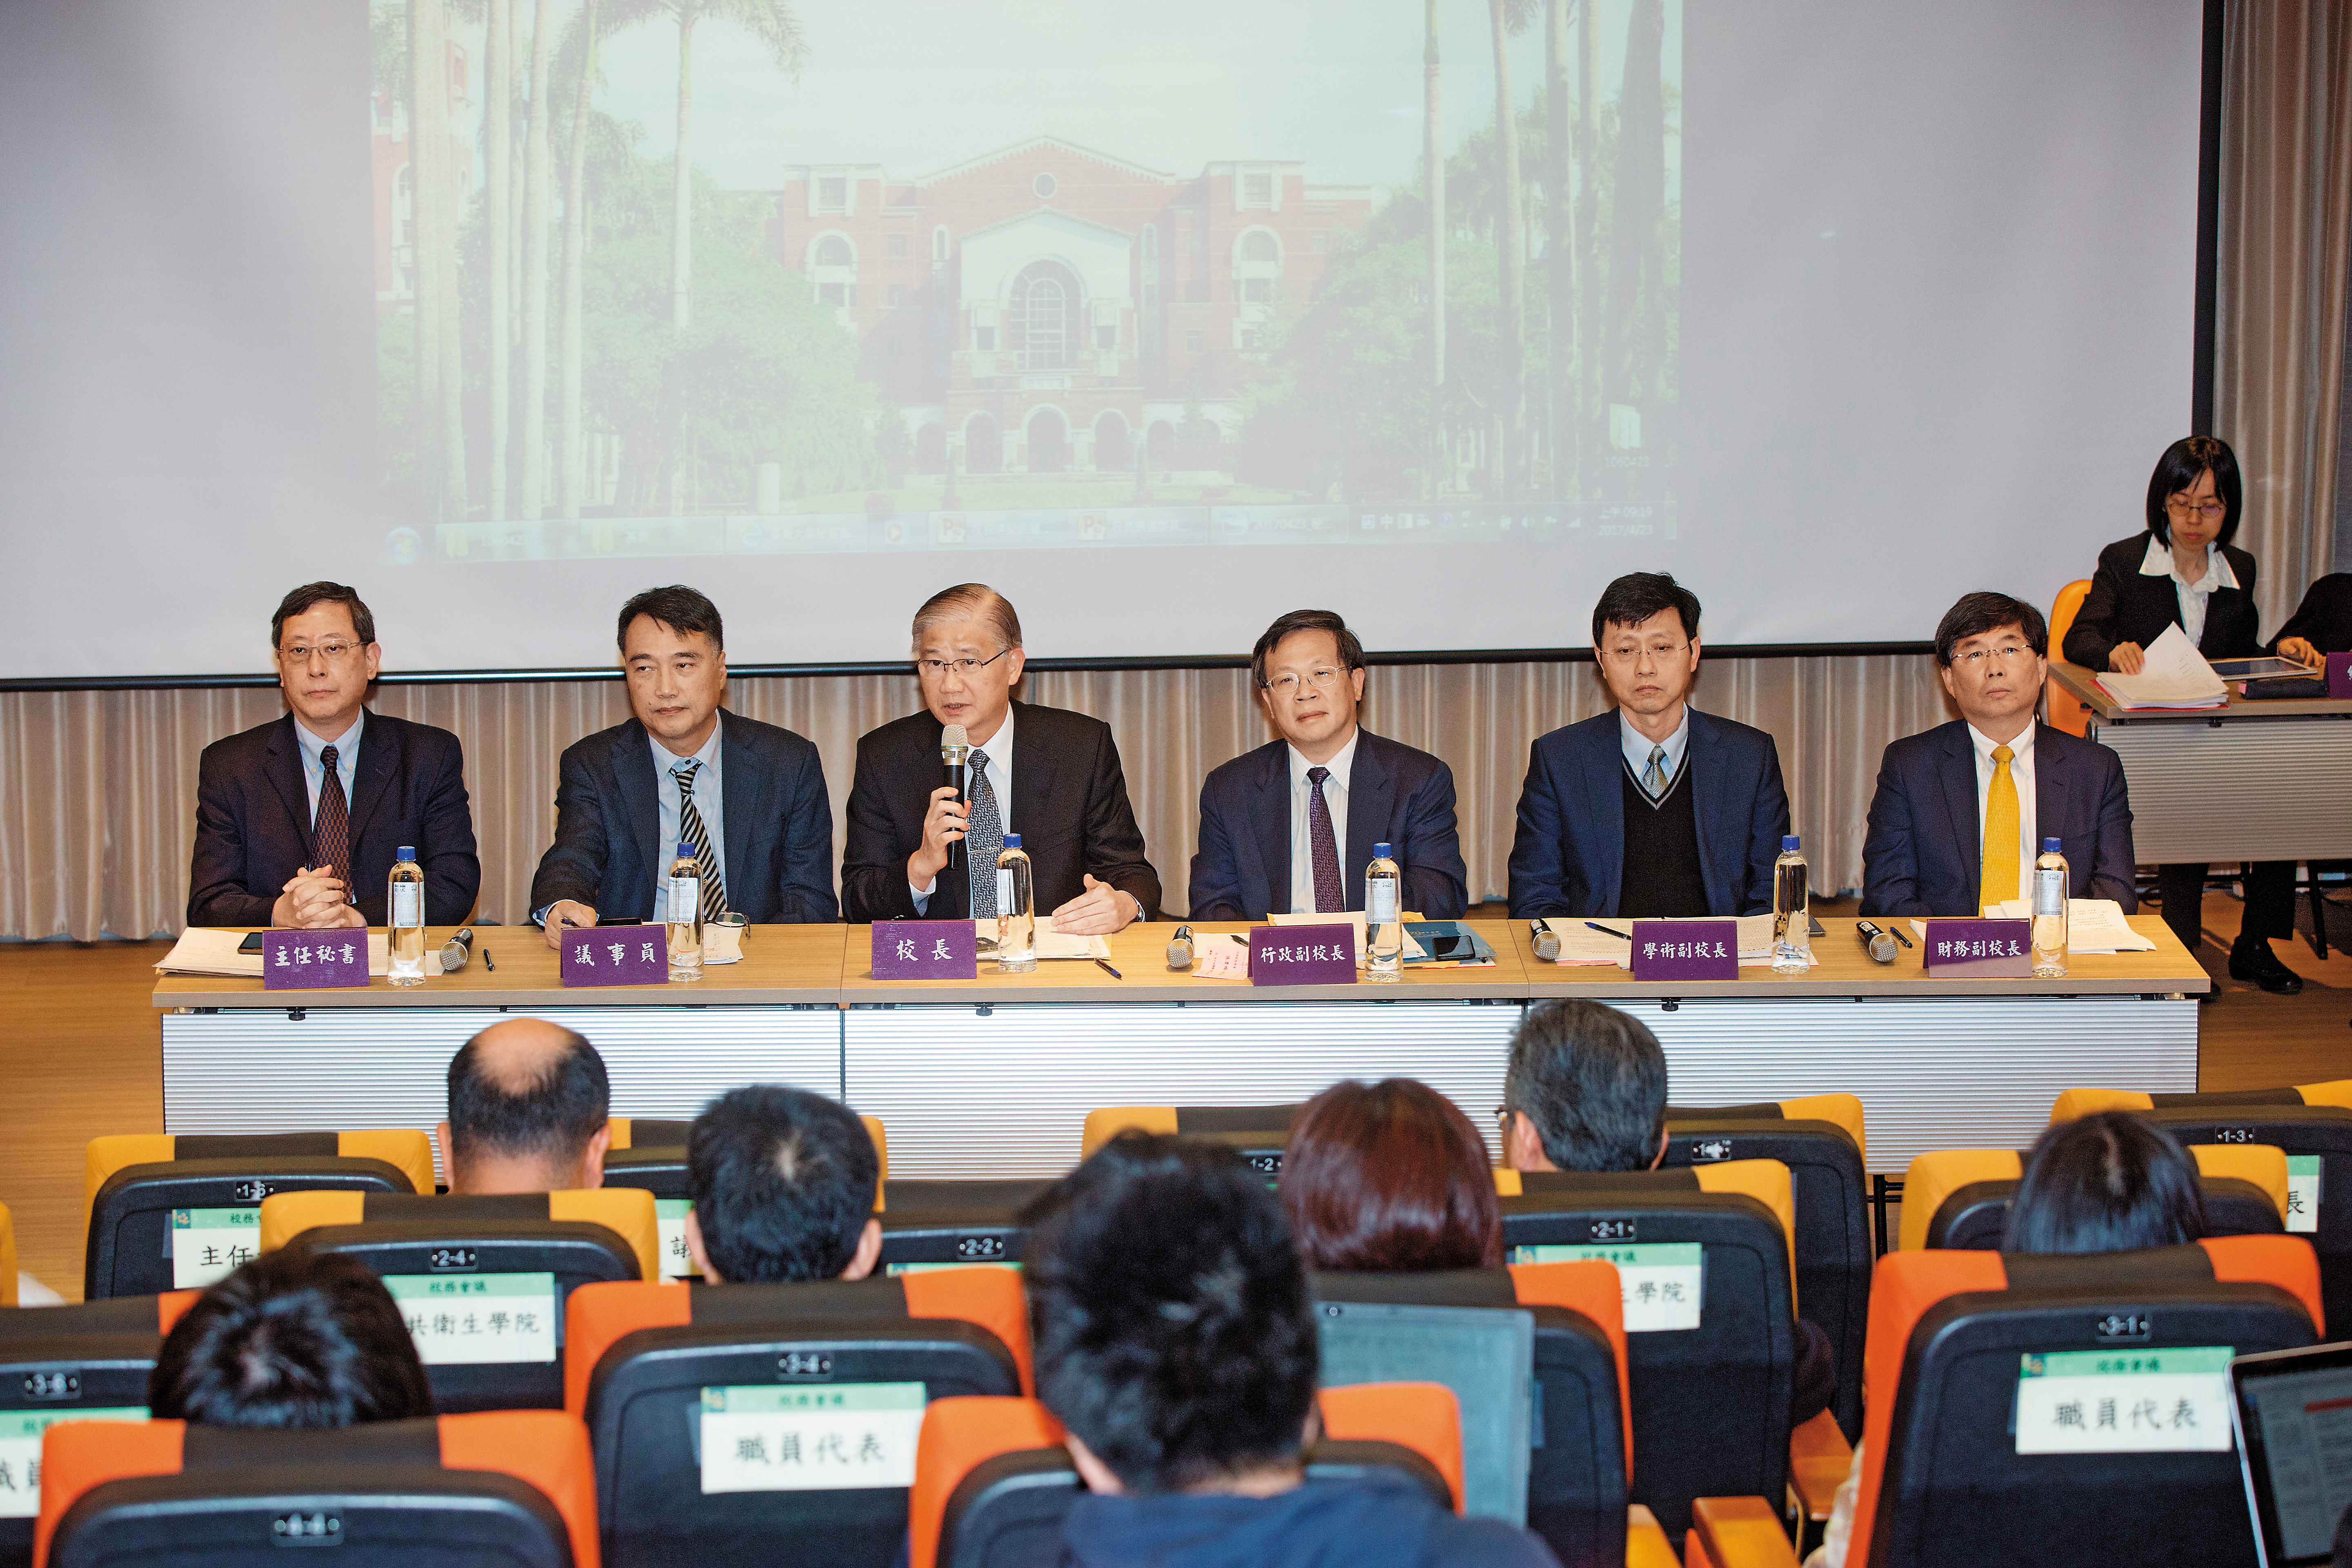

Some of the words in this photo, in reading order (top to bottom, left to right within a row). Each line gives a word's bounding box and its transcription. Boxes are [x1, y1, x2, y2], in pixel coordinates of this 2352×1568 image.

[1381, 514, 1393, 528] 中
[1599, 507, 1621, 520] 上午
[1622, 506, 1653, 517] 09:19
[1598, 524, 1653, 537] 2017/4/23
[275, 943, 356, 967] 主任秘書
[574, 942, 655, 967] 議事員
[896, 938, 953, 961] 校長
[1261, 944, 1345, 964] 行政副校長
[1643, 941, 1728, 960] 學術副校長
[1938, 940, 2022, 958] 財務副校長
[2223, 1130, 2245, 1142] 1-3
[1250, 1157, 1274, 1171] 1-2
[2287, 1191, 2305, 1214] 長
[230, 1213, 261, 1224] 校務
[1597, 1221, 1624, 1238] 2-1
[966, 1238, 994, 1255] 2-2
[200, 1245, 261, 1268] 主任
[438, 1250, 466, 1266] 2-4
[1623, 1281, 1685, 1304] 學院
[2105, 1315, 2138, 1336] 3-1
[2052, 1395, 2198, 1430] 職員代表
[735, 1430, 886, 1465] 職員代表
